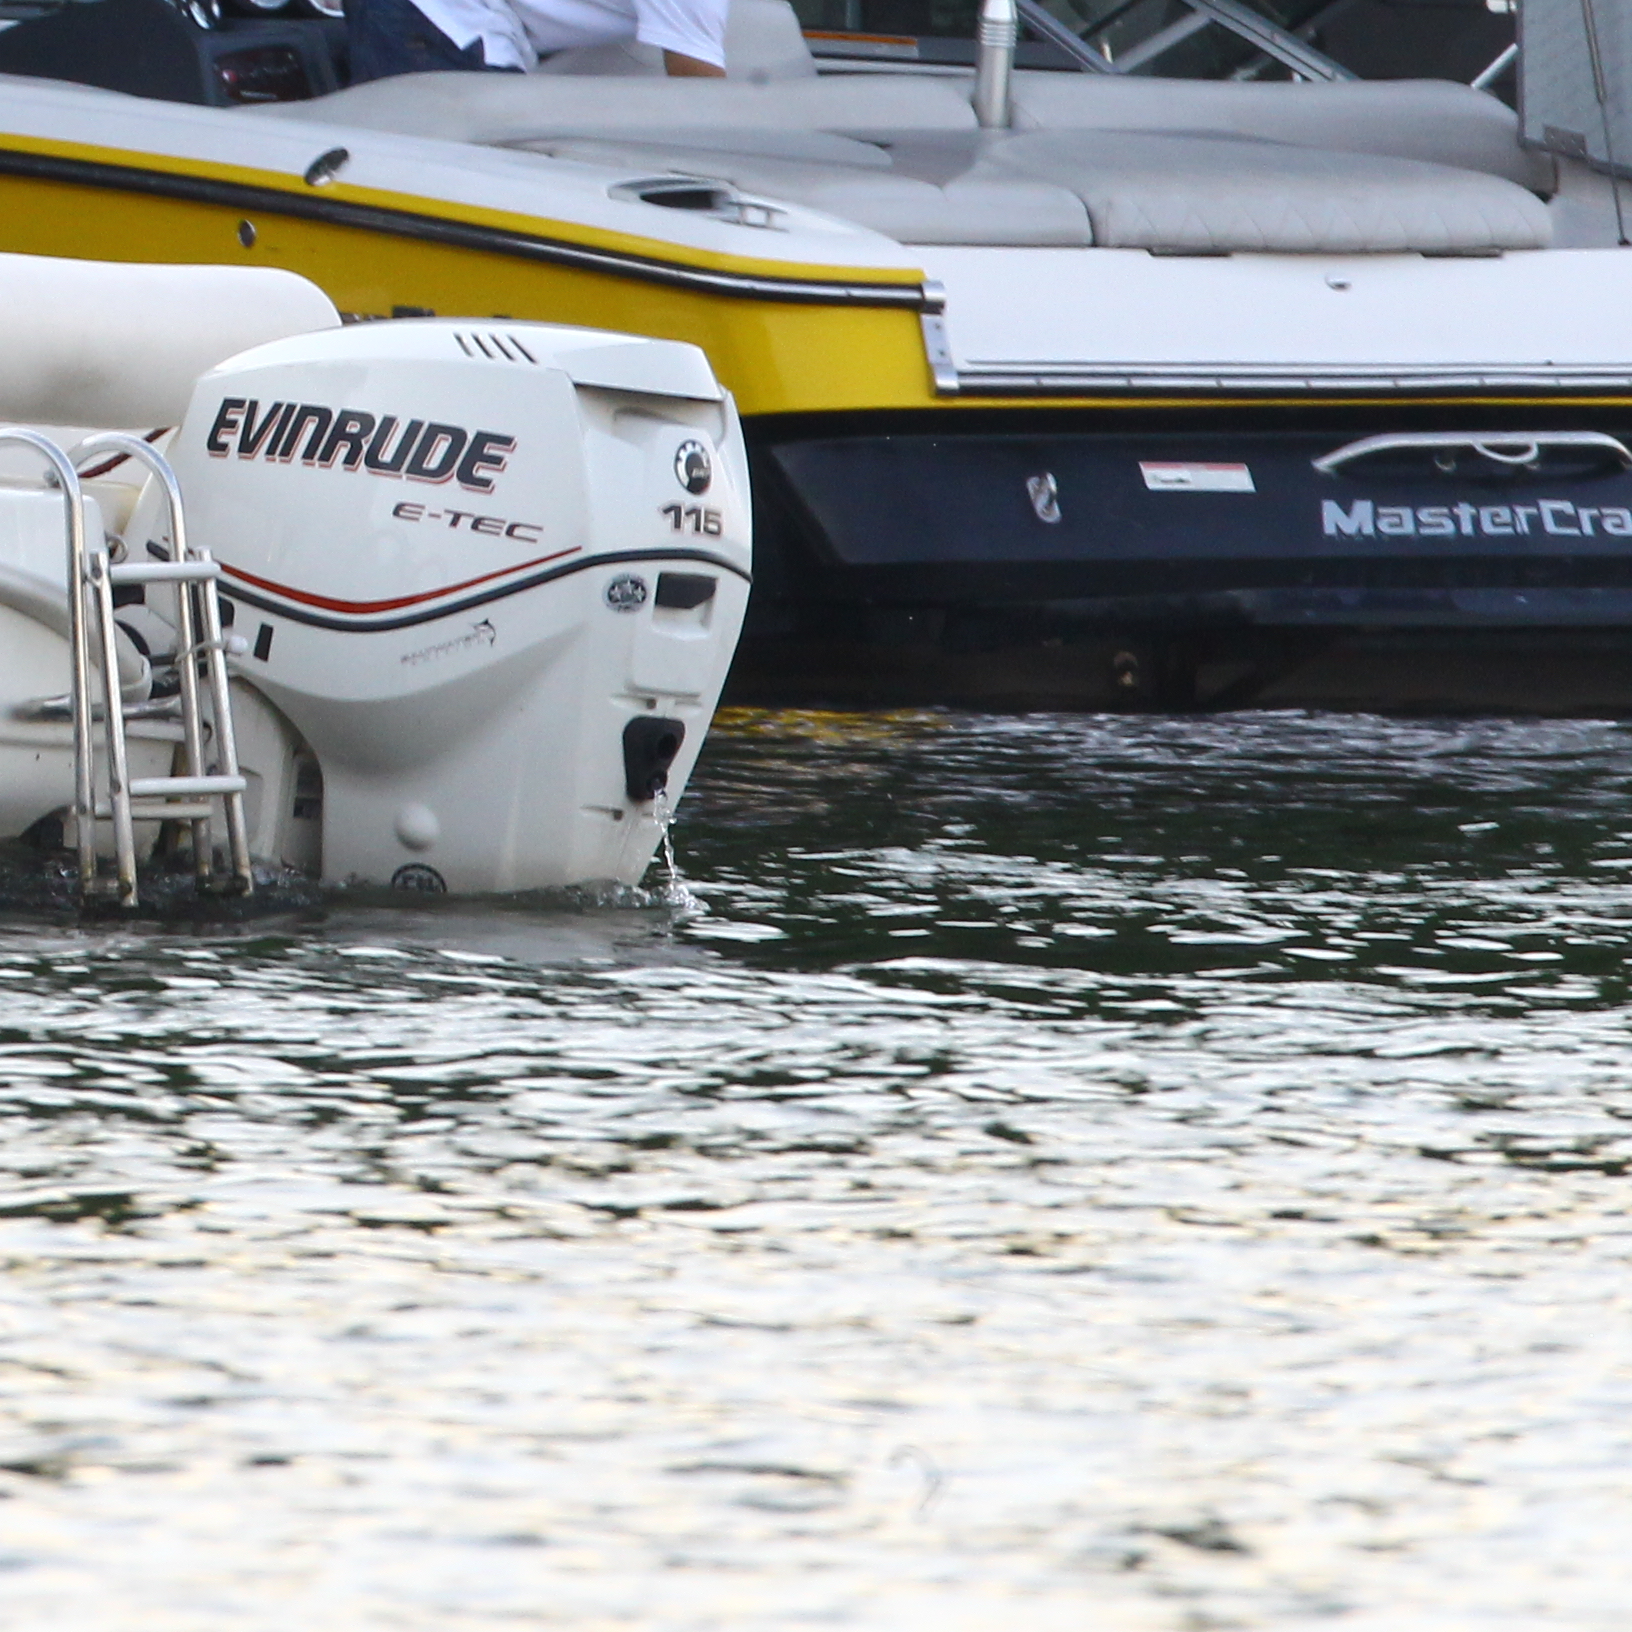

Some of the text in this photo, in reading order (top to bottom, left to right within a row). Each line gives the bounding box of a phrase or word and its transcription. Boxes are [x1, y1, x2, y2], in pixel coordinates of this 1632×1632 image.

[206, 397, 517, 494] EVINRUDE
[392, 502, 544, 543] E-TEC
[660, 503, 724, 537] 115
